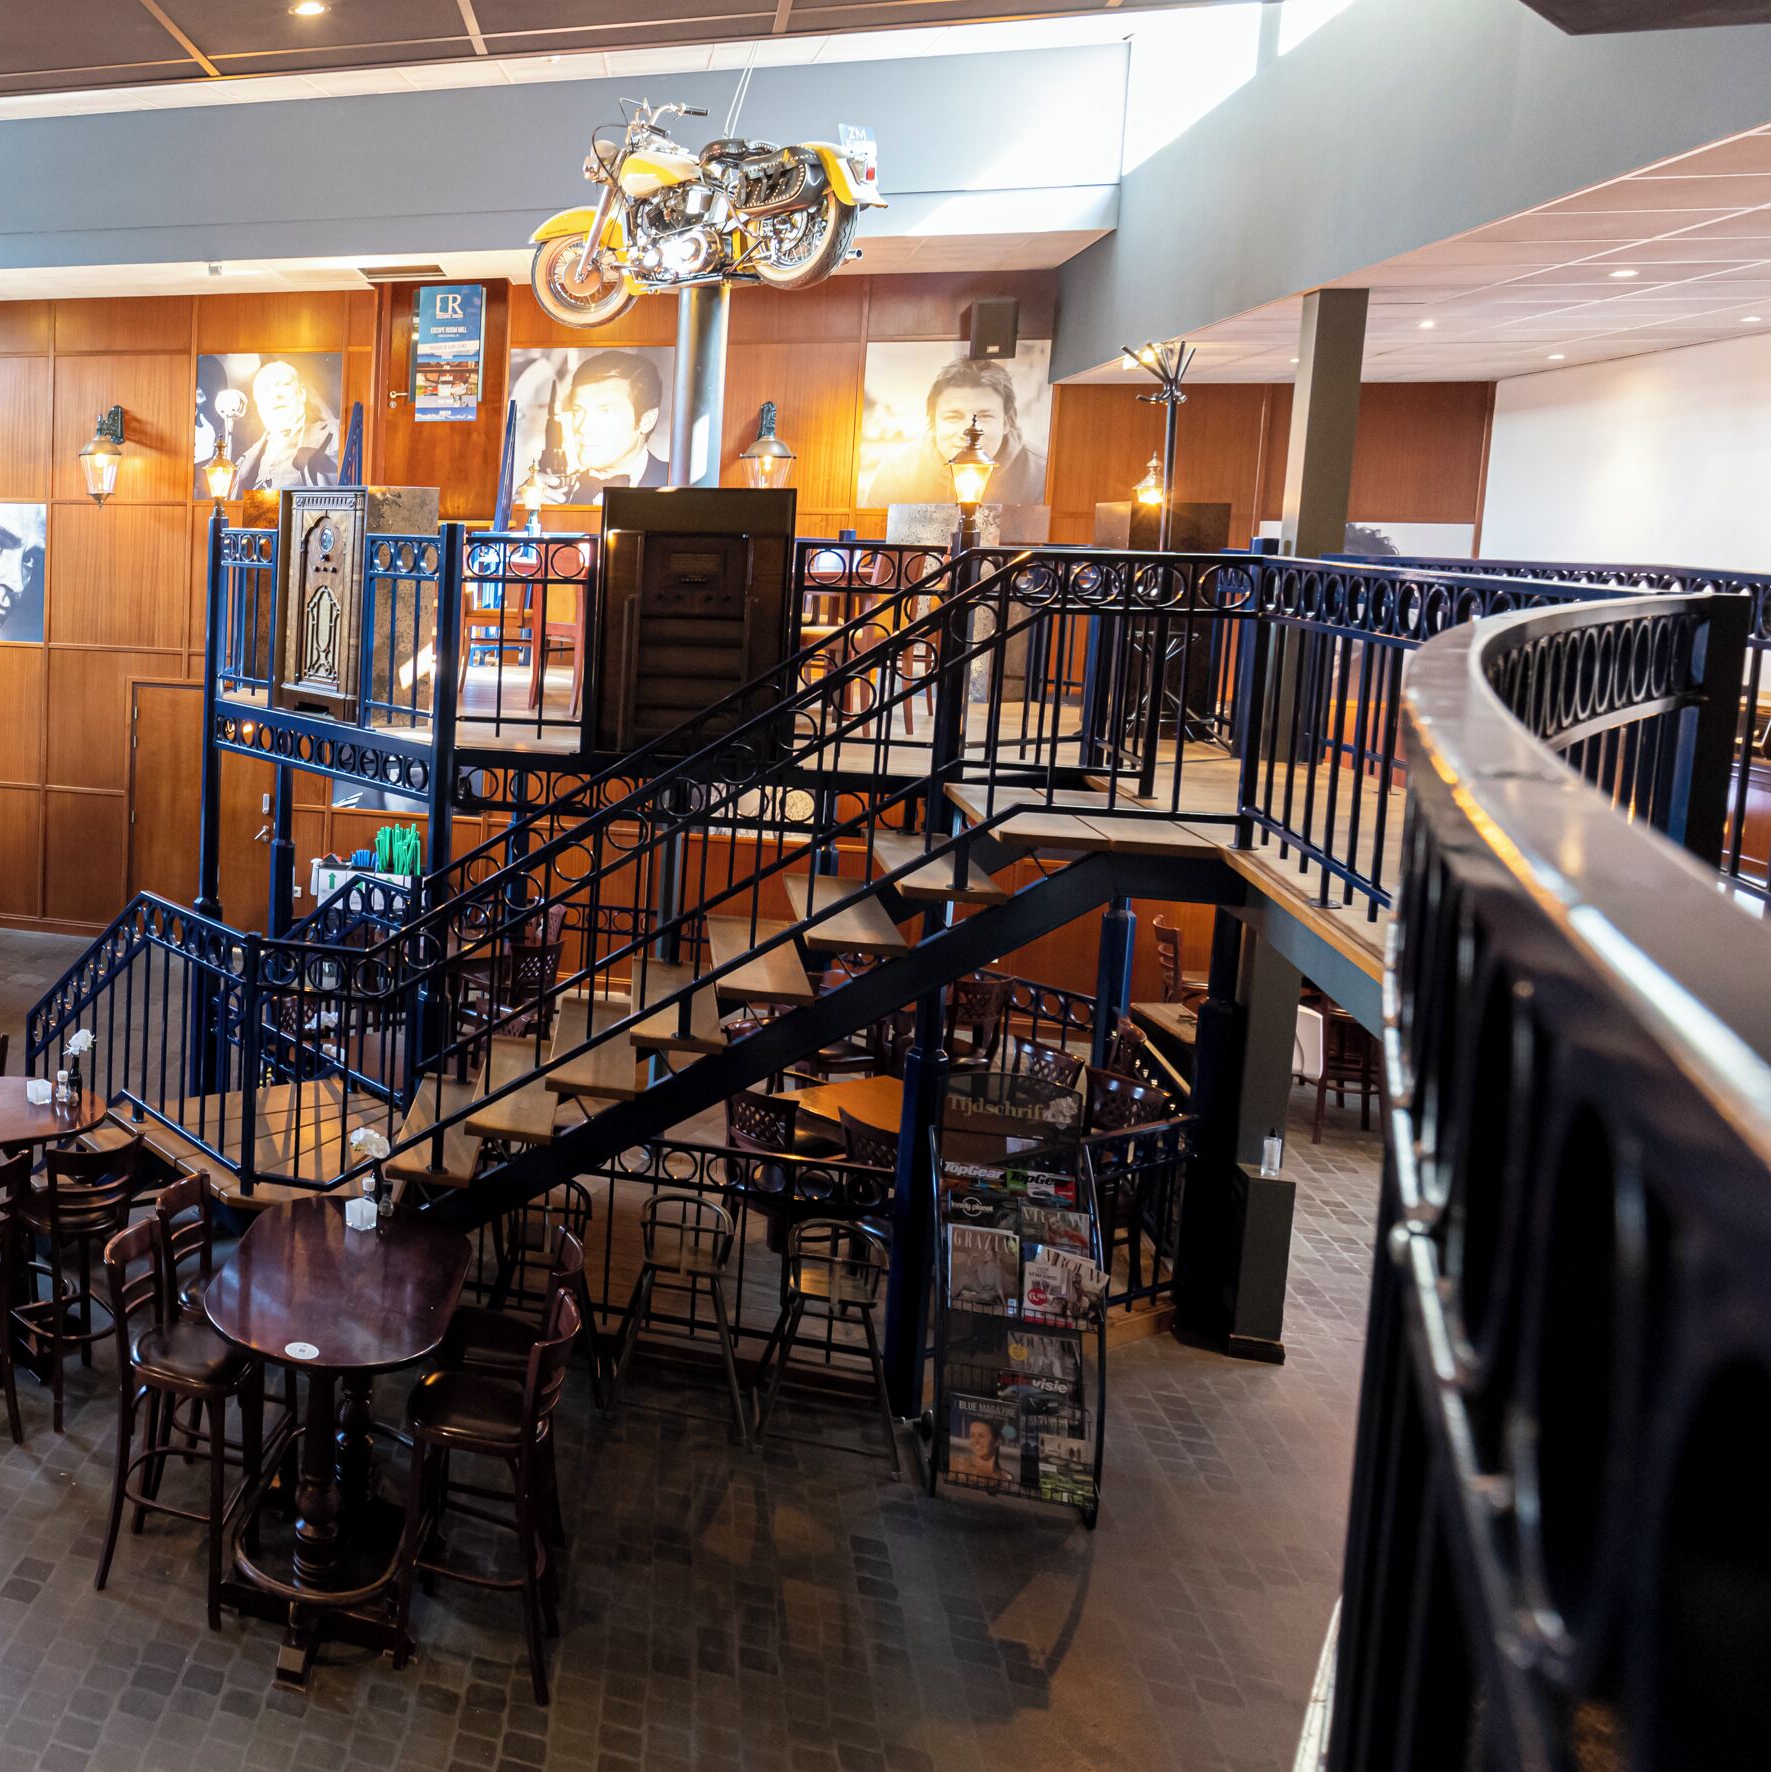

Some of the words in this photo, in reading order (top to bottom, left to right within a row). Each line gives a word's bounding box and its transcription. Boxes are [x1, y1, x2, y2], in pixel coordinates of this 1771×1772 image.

[947, 1095, 1044, 1120] Tijdschrif
[944, 1161, 1005, 1178] TopGear
[1010, 1171, 1068, 1188] TopGe
[951, 1201, 972, 1212] lonely
[971, 1202, 994, 1213] planet
[958, 1400, 977, 1412] BLUE
[979, 1403, 1016, 1418] MAGAZINE
